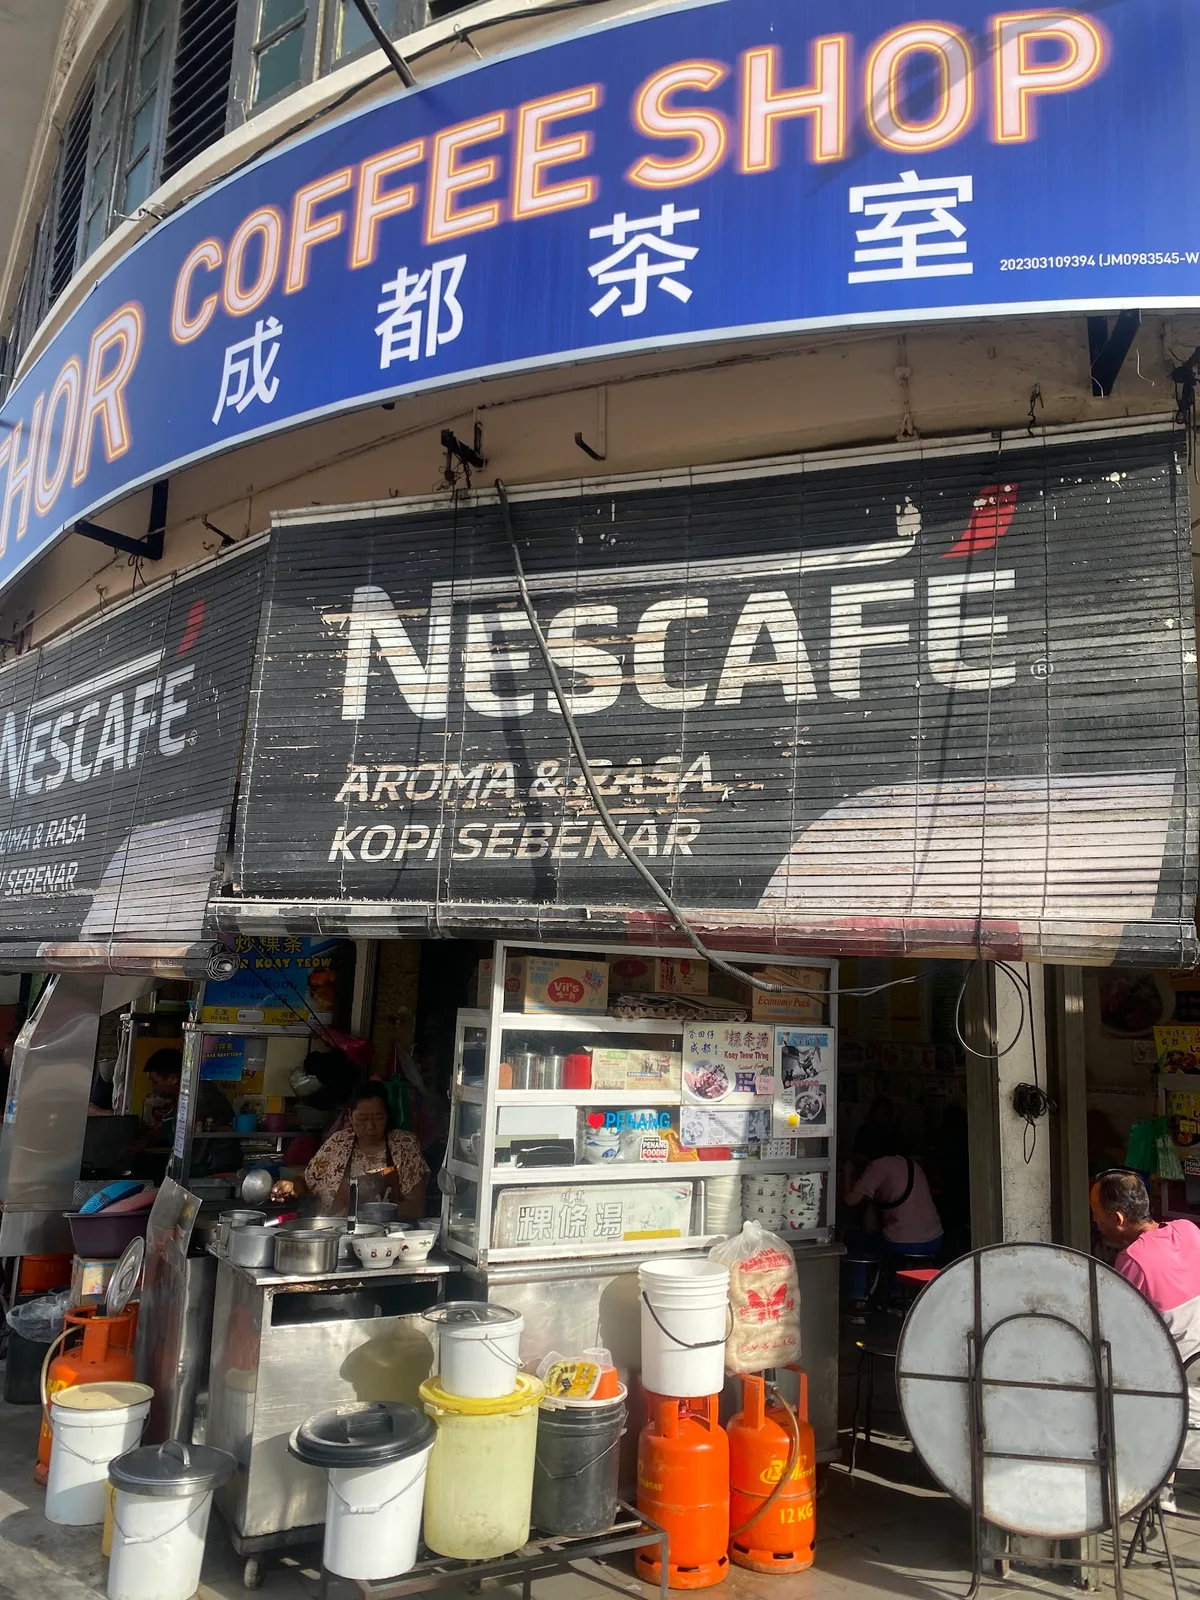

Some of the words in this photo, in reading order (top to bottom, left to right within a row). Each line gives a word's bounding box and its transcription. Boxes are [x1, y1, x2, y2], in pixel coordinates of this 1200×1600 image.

[170, 86, 598, 346] COFFEE
[628, 9, 1106, 188] SHOP
[1000, 254, 1096, 272] 202303109394
[211, 169, 975, 425] 成都茶室
[334, 762, 516, 802] AROMA
[528, 759, 566, 798] &
[0, 825, 31, 855] OMA
[33, 822, 44, 850] &
[45, 813, 87, 847] RASA
[327, 823, 444, 864] KOPI
[451, 817, 702, 862] SEBENAR
[5, 861, 79, 896] SEBENAR
[254, 957, 292, 969] KOAY
[296, 956, 333, 968] TEOW
[553, 981, 580, 993] Vit's
[757, 995, 792, 1009] Economy
[793, 996, 811, 1008] Pack
[739, 1050, 754, 1059] Teow
[605, 1111, 671, 1132] PENANG
[643, 1141, 668, 1149] PENANG
[643, 1148, 668, 1158] FOODIE
[780, 1507, 796, 1524] 12
[797, 1501, 813, 1522] KG
